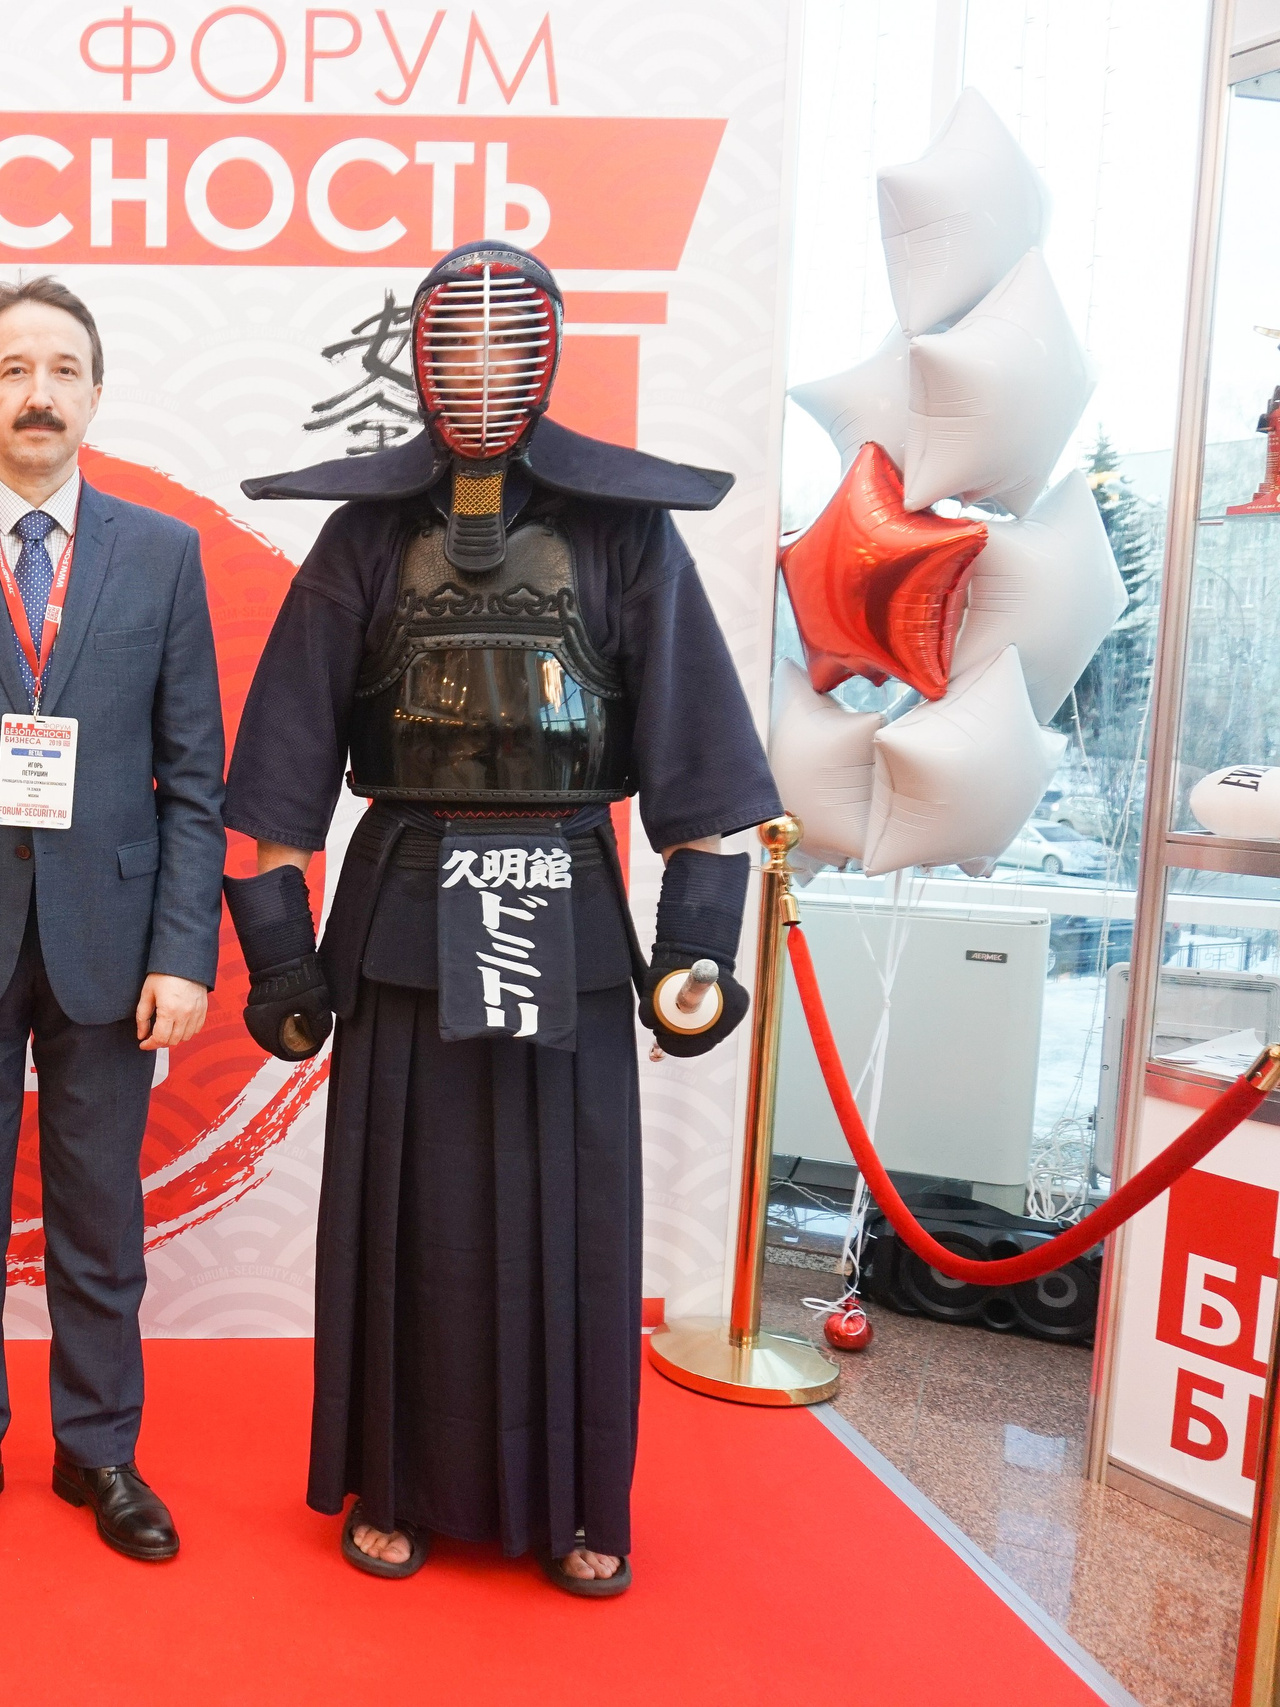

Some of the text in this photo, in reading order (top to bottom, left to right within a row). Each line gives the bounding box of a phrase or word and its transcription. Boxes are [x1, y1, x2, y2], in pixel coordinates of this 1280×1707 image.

[80, 4, 559, 106] ФОРУМ
[5, 727, 71, 739] БЕЗОПАСНОСТЬ
[5, 736, 41, 745] БИЗНЕСА
